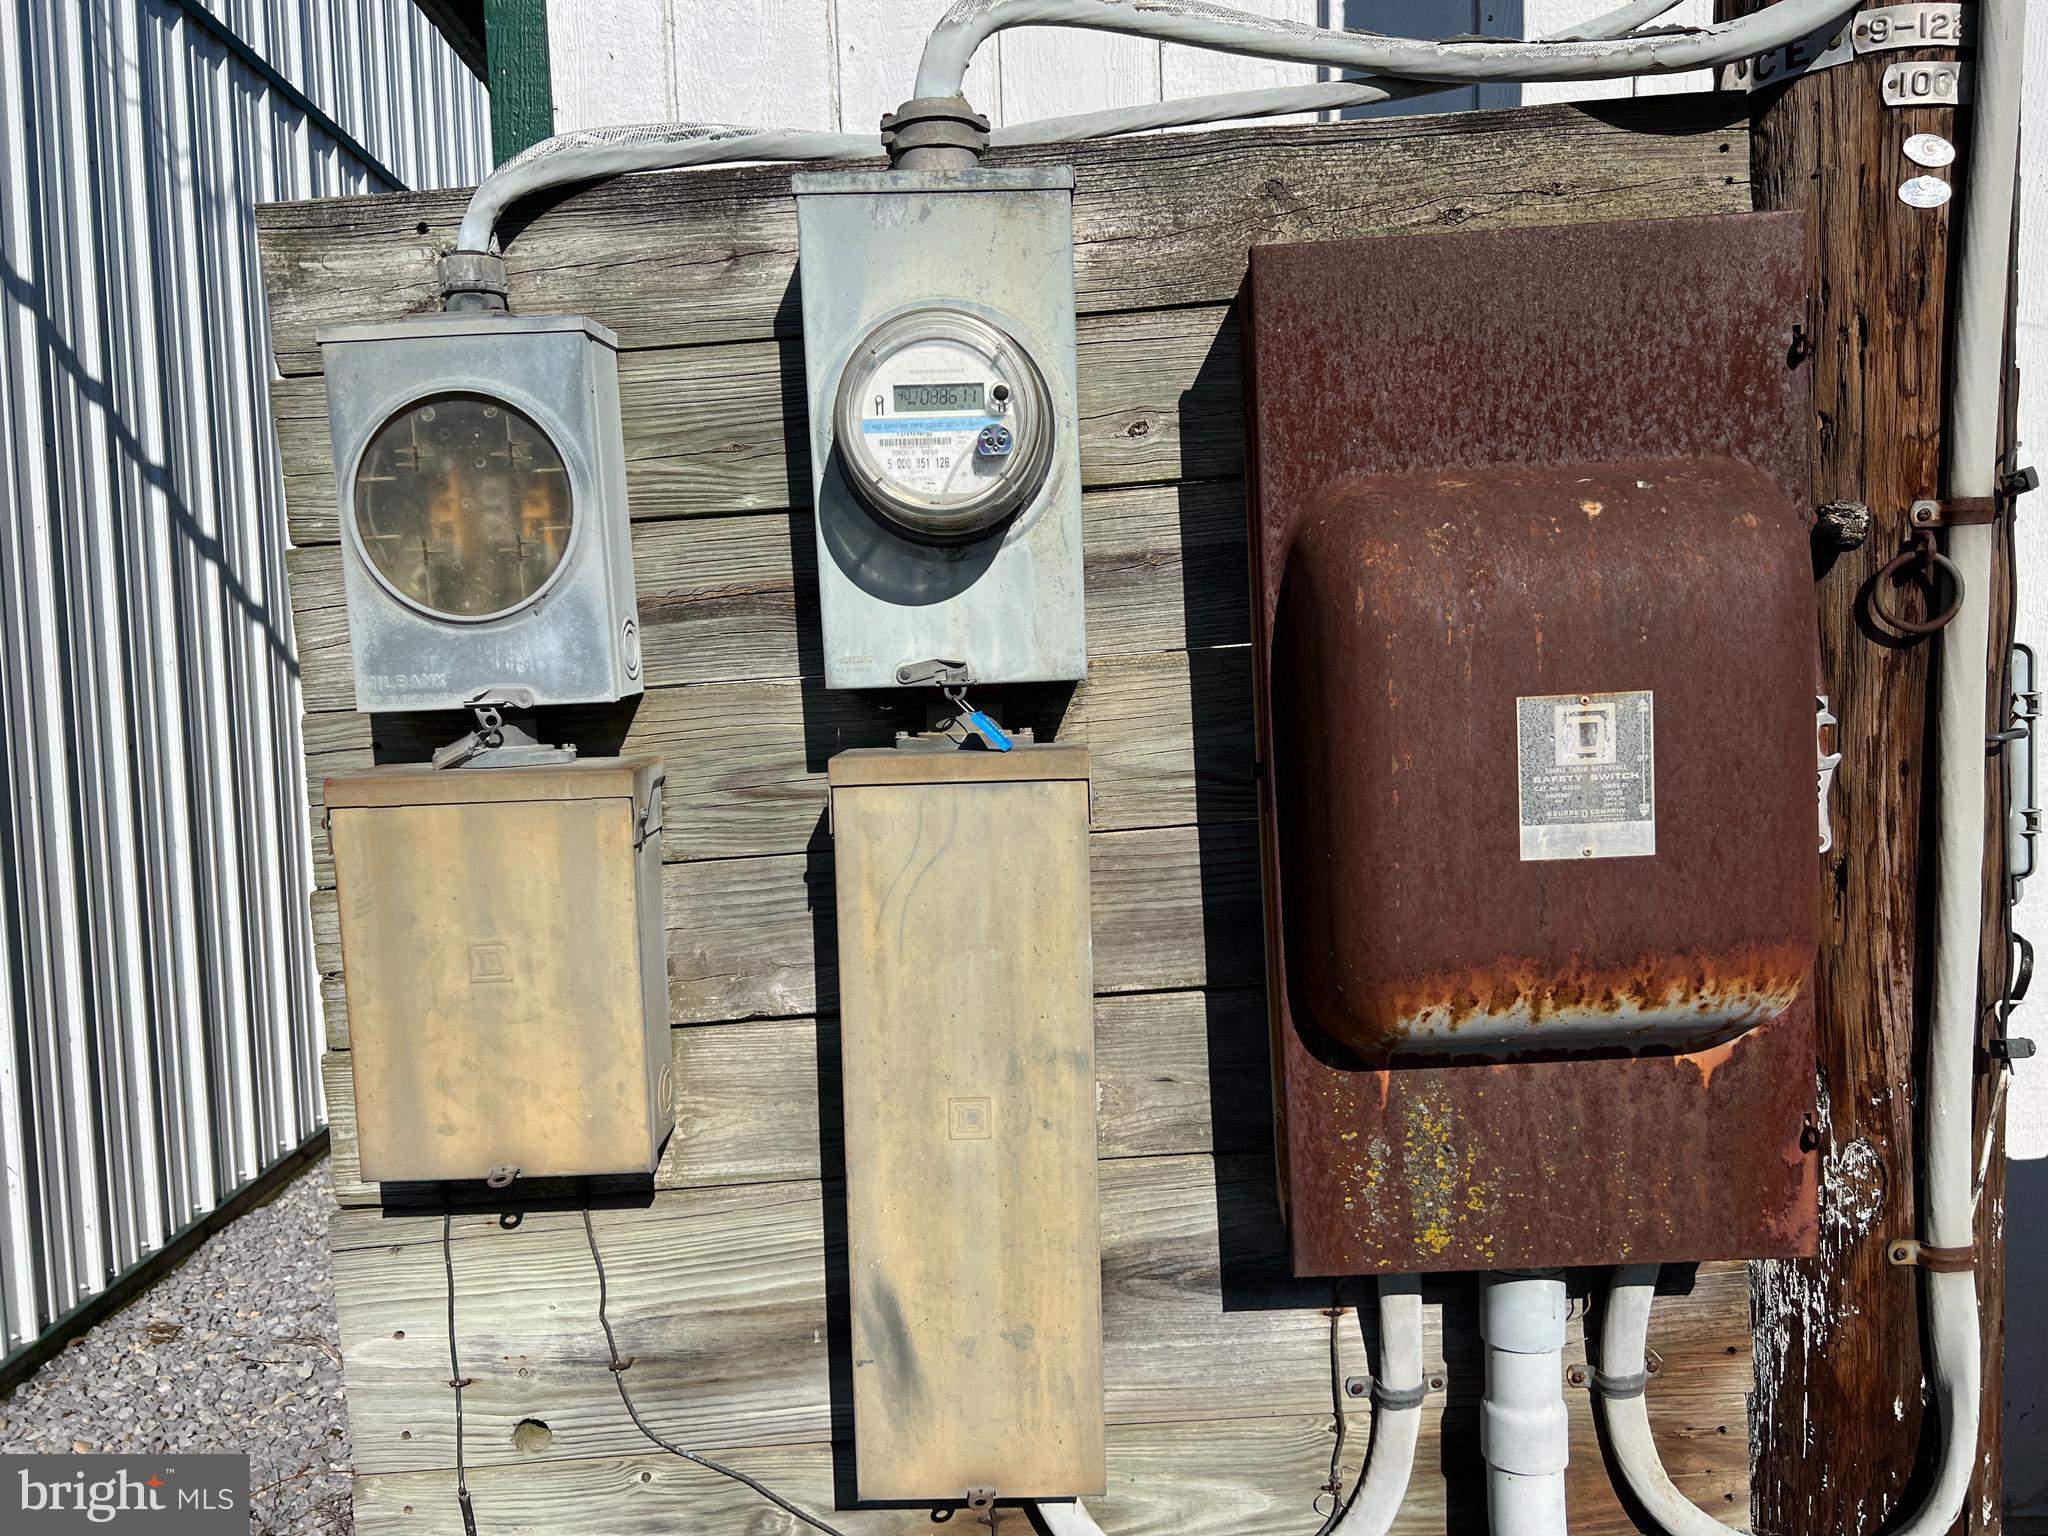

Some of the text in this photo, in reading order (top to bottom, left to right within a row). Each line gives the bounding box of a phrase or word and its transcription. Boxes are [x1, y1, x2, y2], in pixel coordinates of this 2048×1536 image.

[897, 457, 911, 469] 000
[935, 456, 950, 468] 126
[1533, 772, 1639, 783] SAFETY SWITCH
[1547, 809, 1579, 817] SQUARE
